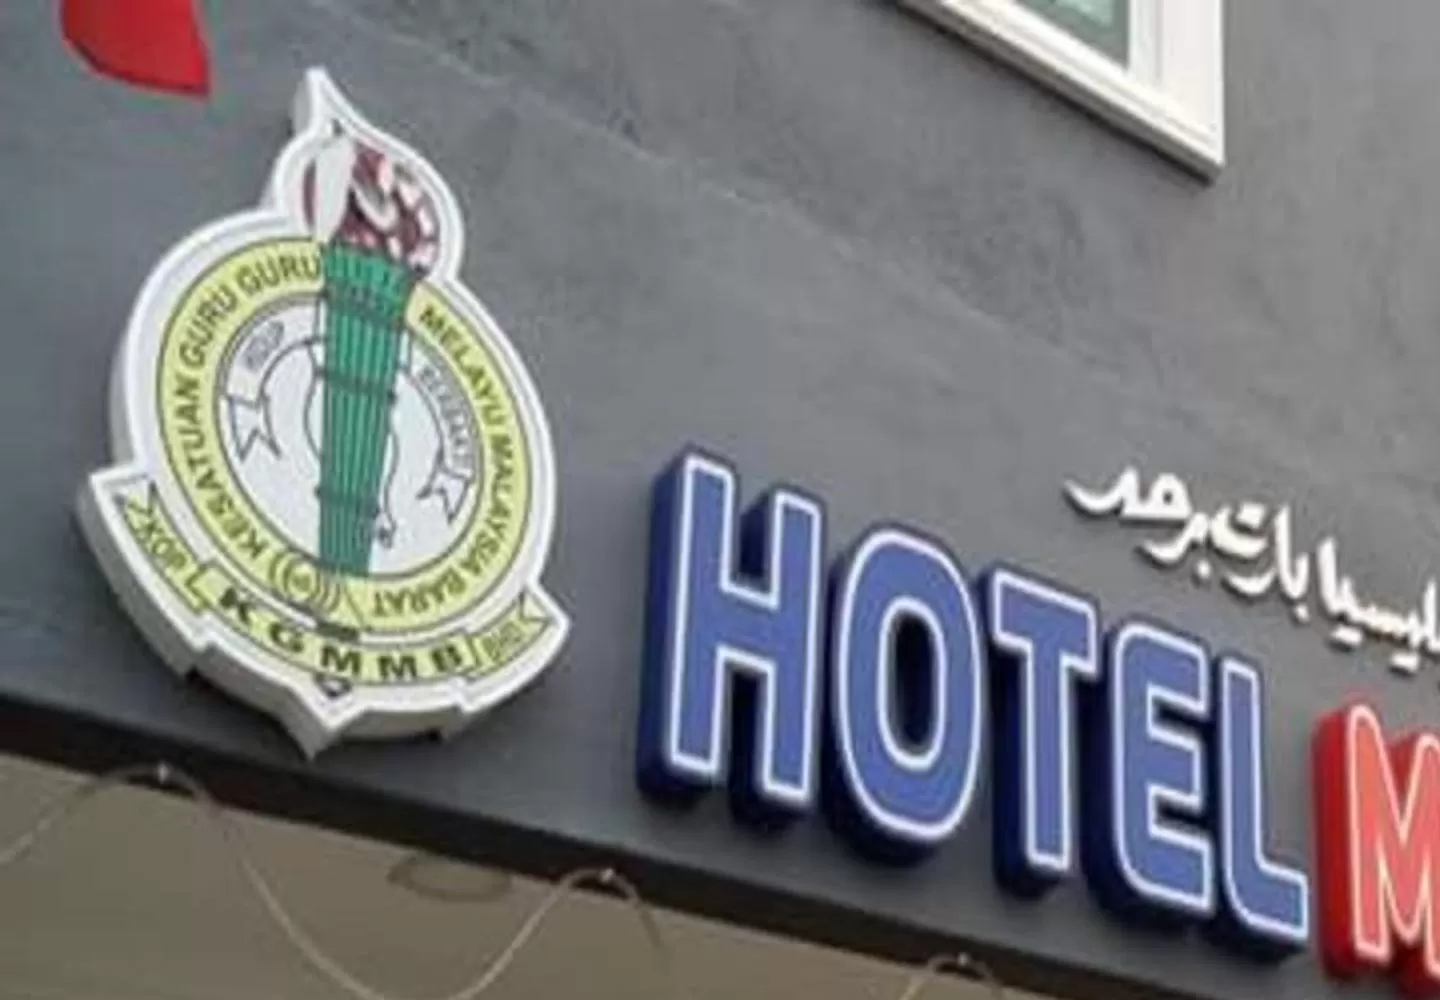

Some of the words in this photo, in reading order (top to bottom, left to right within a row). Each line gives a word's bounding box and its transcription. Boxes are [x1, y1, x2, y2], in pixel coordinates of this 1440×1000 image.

[179, 283, 238, 369] GURU
[235, 254, 321, 296] GURU
[419, 303, 508, 426] MELAYU
[173, 372, 270, 560] KESATUAN
[219, 587, 464, 680] KGMMB
[640, 448, 1309, 945] HOTEL
